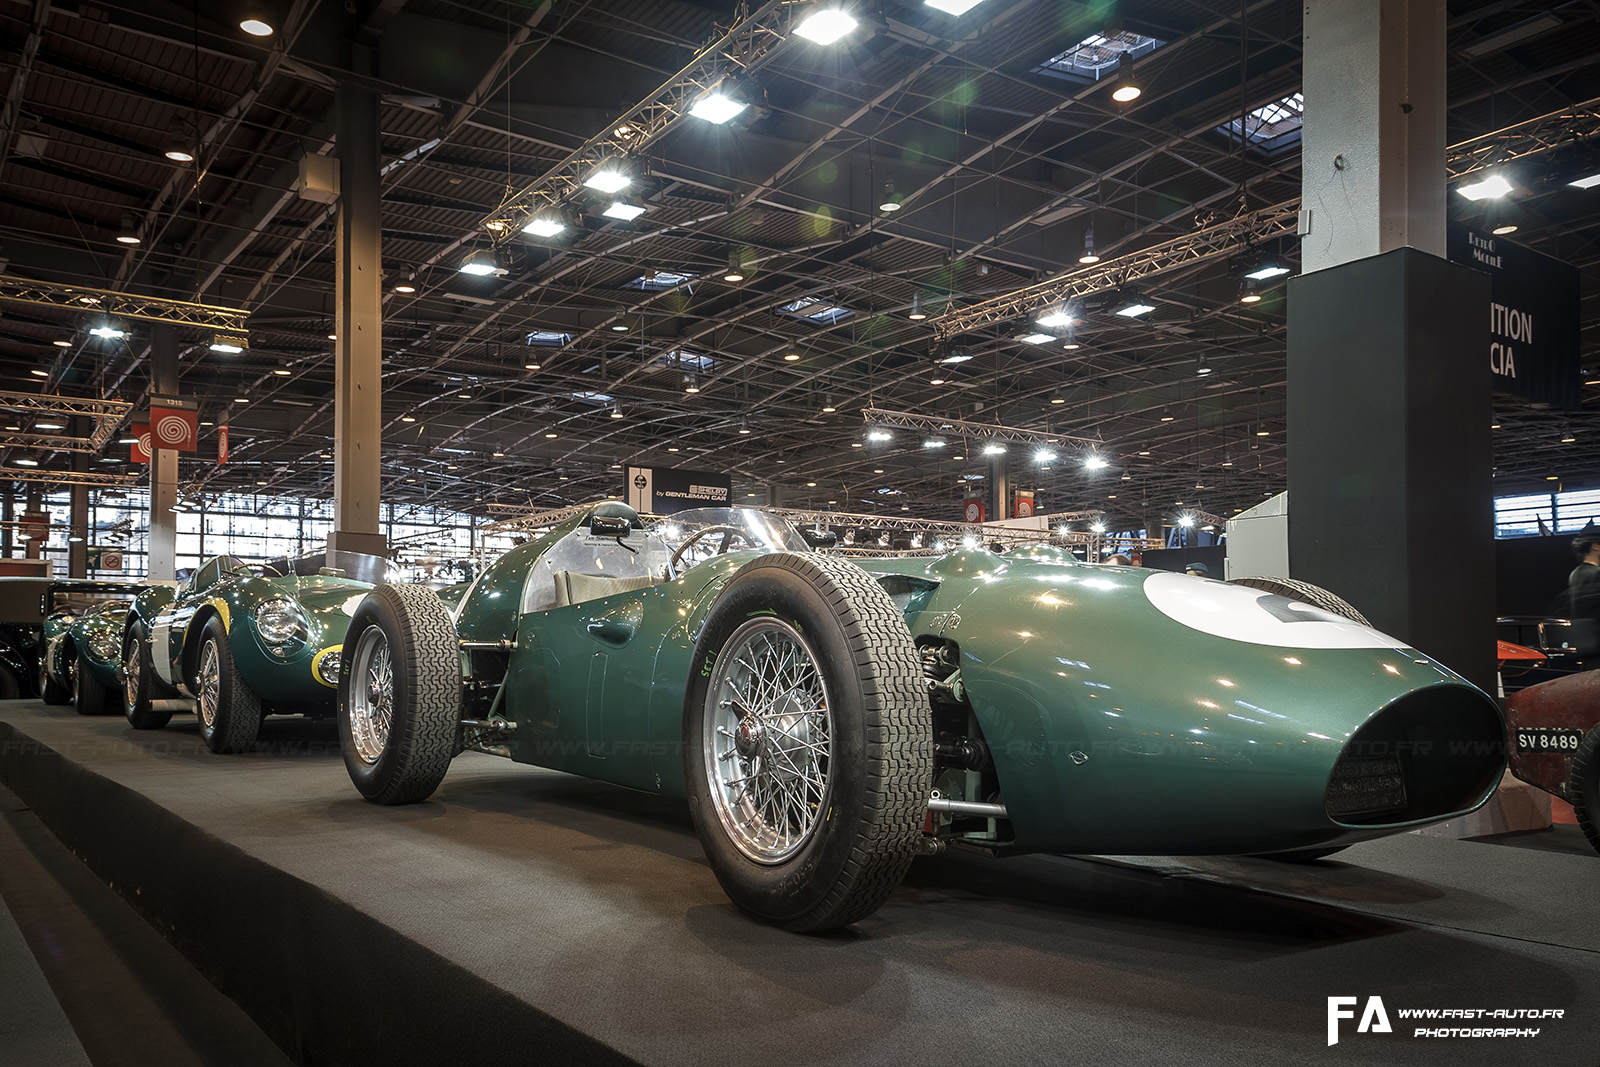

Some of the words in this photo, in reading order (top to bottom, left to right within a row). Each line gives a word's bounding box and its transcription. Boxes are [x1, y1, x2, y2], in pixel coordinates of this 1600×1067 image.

[665, 492, 710, 500] GENTLEMAN
[1519, 734, 1536, 748] SV
[1540, 735, 1578, 749] 8489
